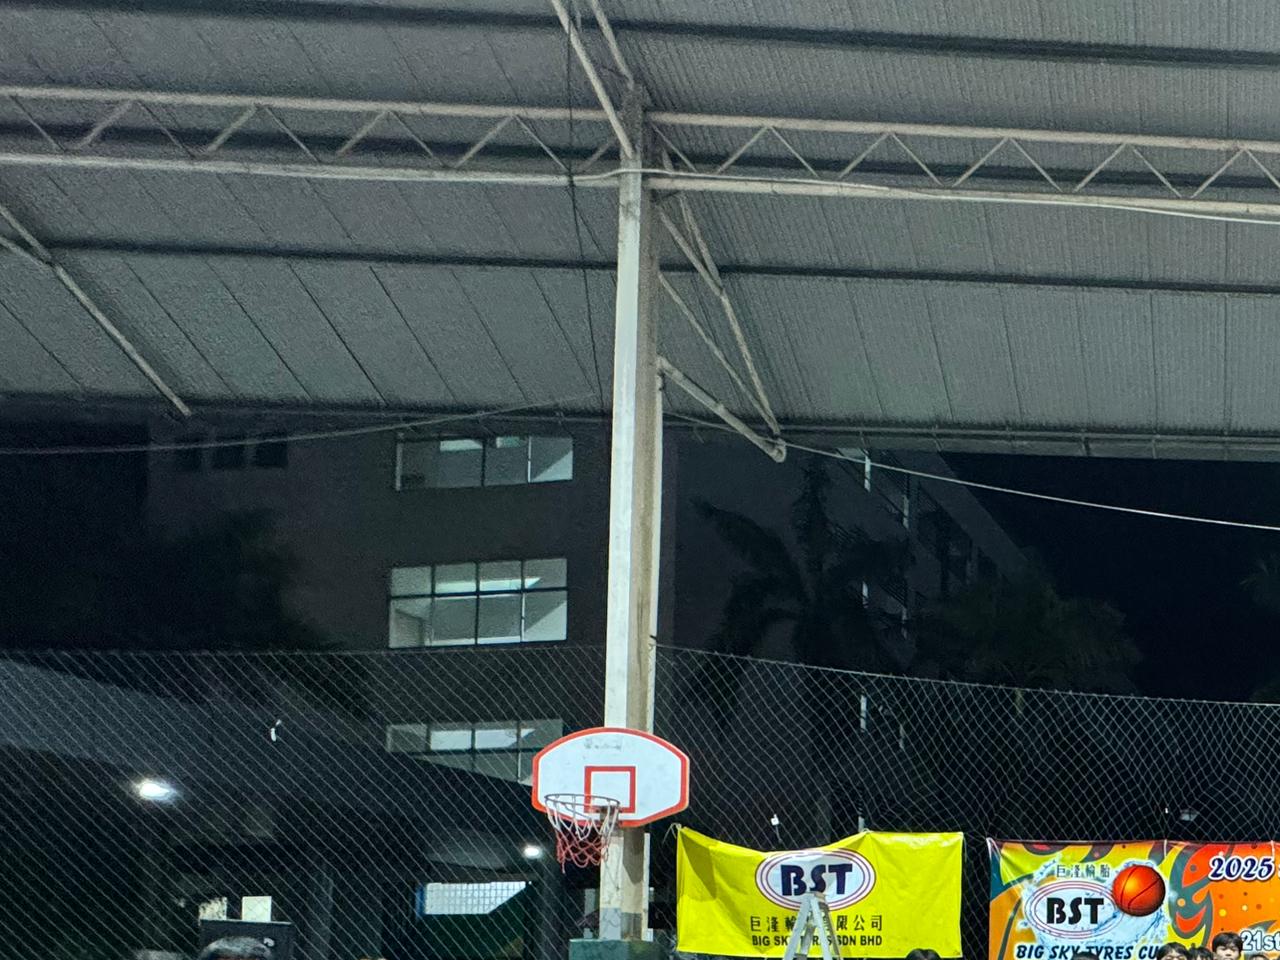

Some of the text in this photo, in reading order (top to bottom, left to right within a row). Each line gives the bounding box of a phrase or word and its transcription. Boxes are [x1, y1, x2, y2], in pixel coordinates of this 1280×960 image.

[780, 864, 853, 896] BST
[1046, 896, 1104, 925] BST
[752, 935, 771, 946] BIG
[774, 935, 793, 946] SK
[860, 935, 882, 946] BHD
[1016, 944, 1044, 959] BIG
[1138, 945, 1159, 960] CU
